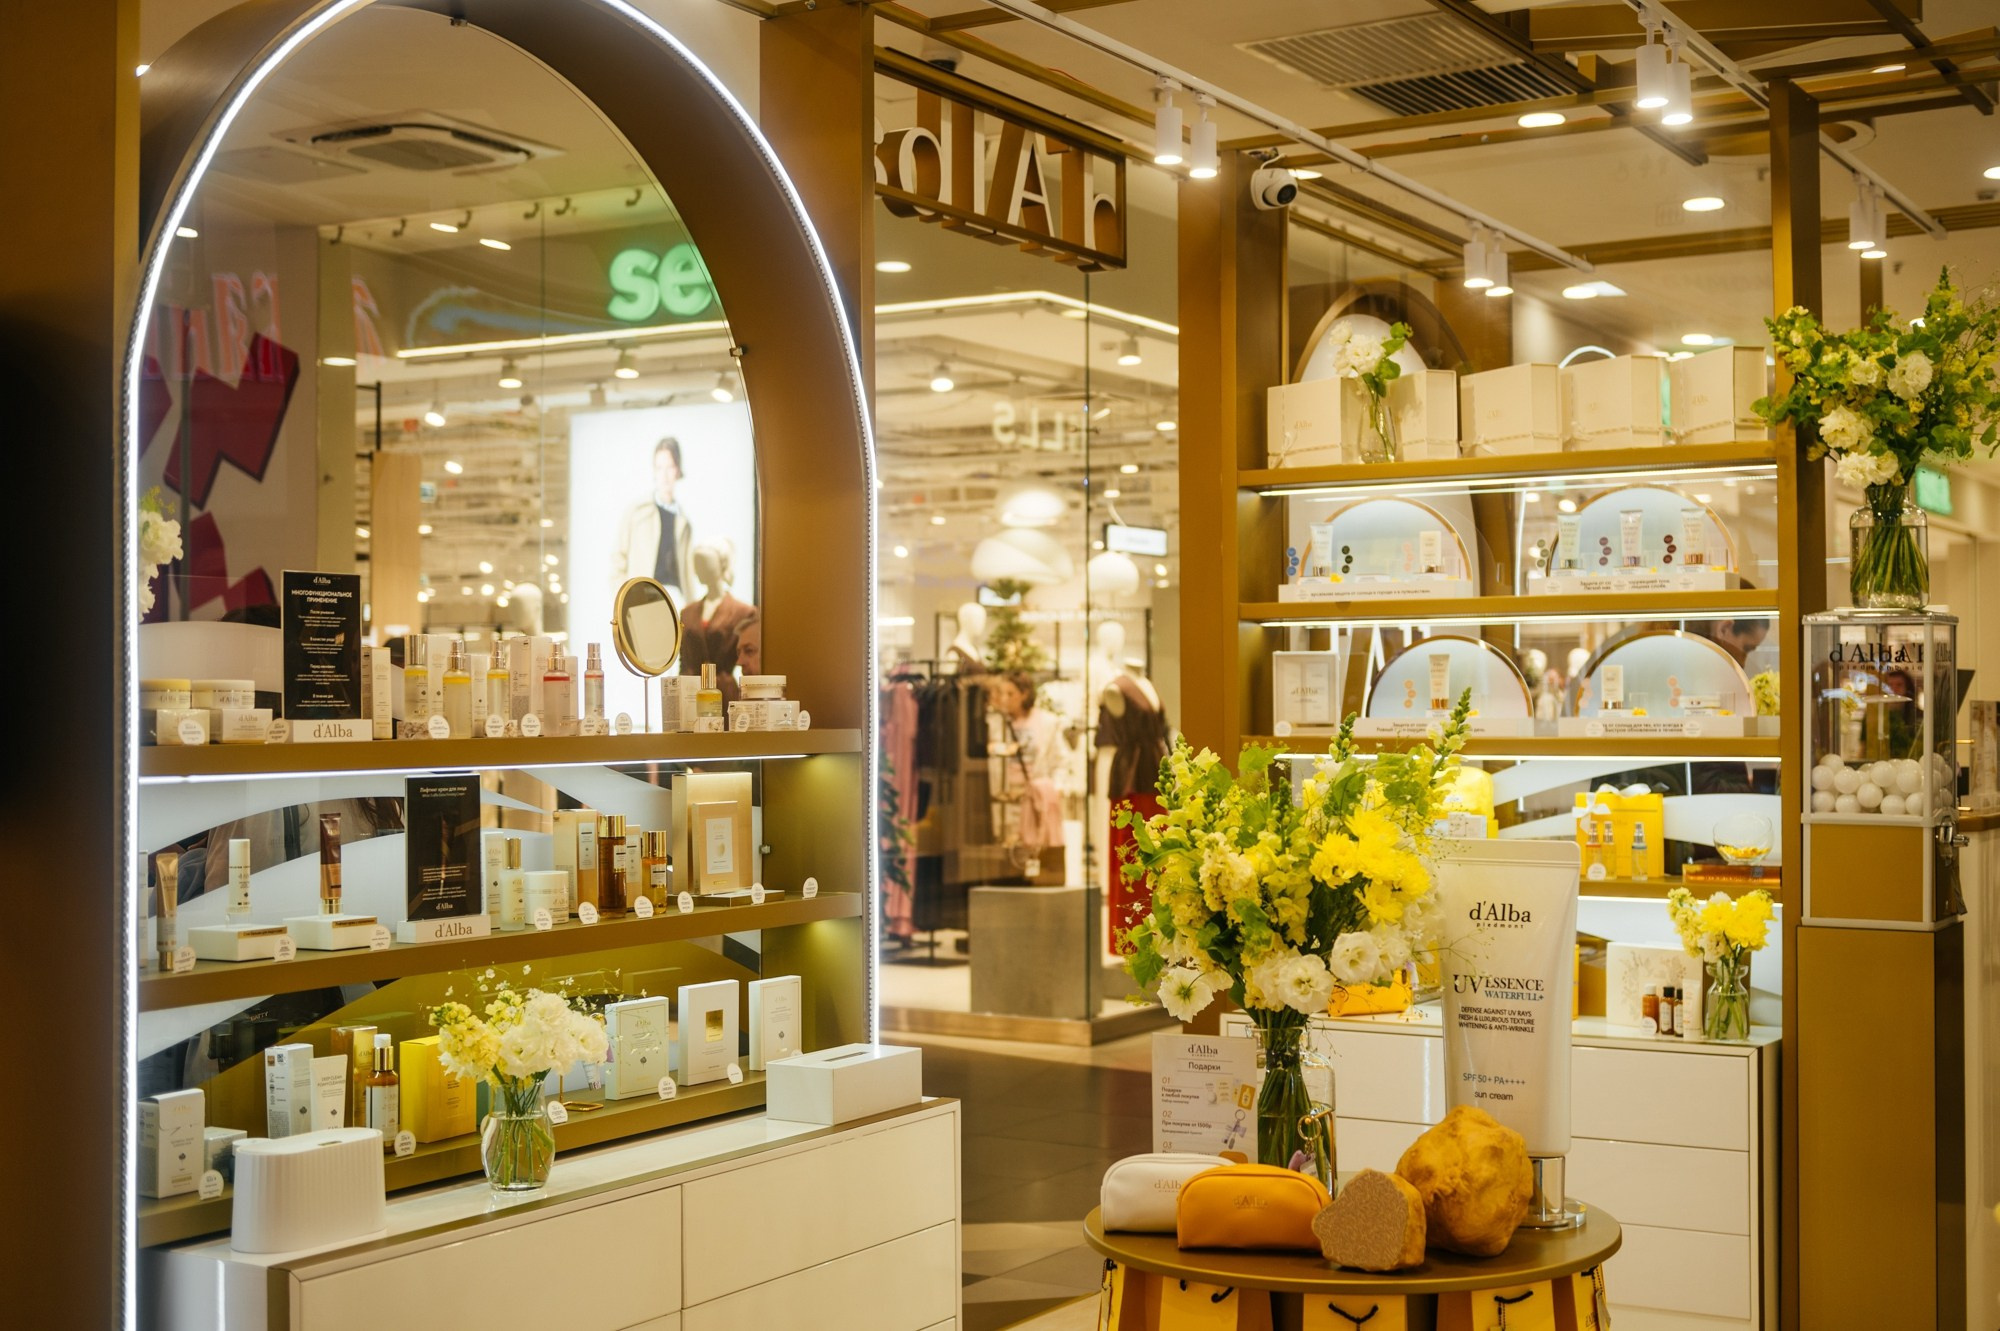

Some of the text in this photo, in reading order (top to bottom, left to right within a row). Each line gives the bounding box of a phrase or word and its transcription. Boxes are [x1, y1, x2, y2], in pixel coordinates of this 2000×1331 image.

[313, 576, 331, 584] d'Alba
[291, 589, 353, 598] МНОГОФУНКЦИОНАЛЬНОЕ
[306, 596, 338, 604] ПРИМЕНЕНИЕ
[313, 723, 353, 738] d'Alba
[436, 902, 453, 911] d'Alba
[1469, 900, 1531, 922] d'Alba
[435, 922, 473, 938] d'Alba
[1485, 976, 1544, 991] ESSENCE
[1485, 990, 1544, 1001] WATERFULL+
[1461, 1006, 1482, 1014] DEFENSE
[1483, 1007, 1507, 1016] AGAINST
[1517, 1010, 1532, 1018] RAYS
[1459, 1013, 1473, 1021] FRESH
[1479, 1015, 1509, 1024] LUXURIOUS
[1510, 1018, 1535, 1026] TEXTURE
[1459, 1021, 1488, 1030] WHITENING
[1494, 1023, 1535, 1034] ANTI-WRINKLE
[1188, 1044, 1218, 1055] d'Alba
[1188, 1062, 1221, 1073] Подарки
[1463, 1072, 1525, 1085] SPF 50+ PA++++
[1489, 1093, 1514, 1101] cream
[1162, 1110, 1172, 1118] 02
[1162, 1141, 1172, 1149] 03
[1154, 1179, 1182, 1190] d'Alb
